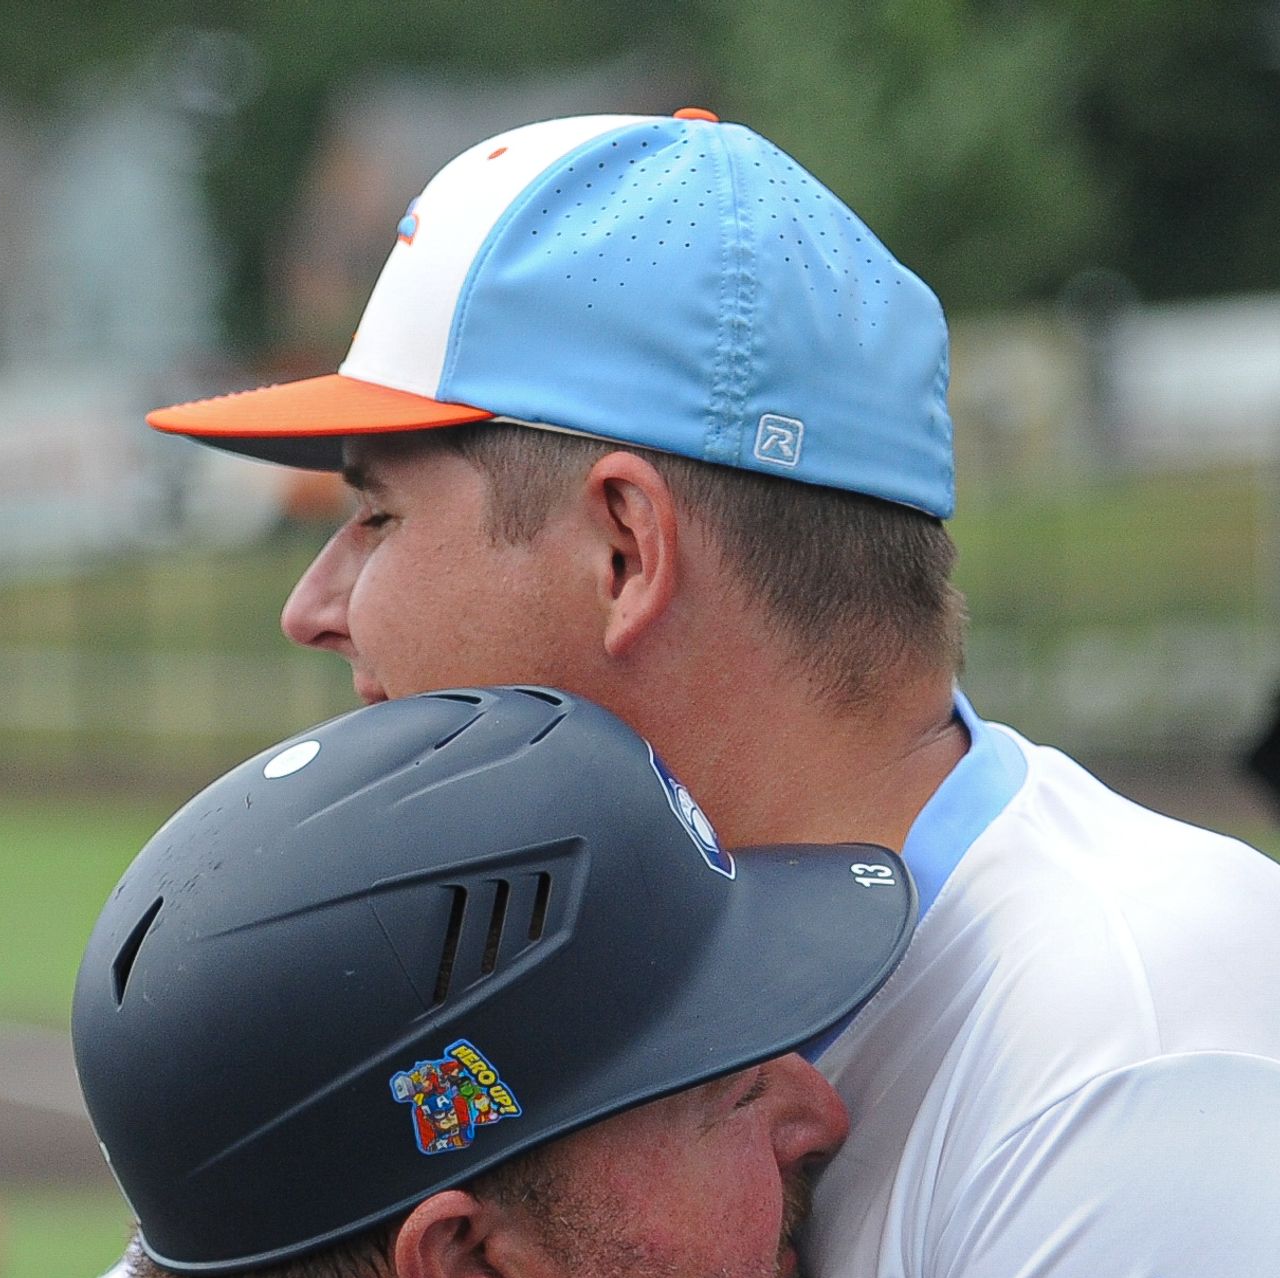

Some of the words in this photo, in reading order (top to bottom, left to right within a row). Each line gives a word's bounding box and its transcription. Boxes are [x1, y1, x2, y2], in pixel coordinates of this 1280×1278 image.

[850, 863, 895, 888] 13
[451, 1045, 496, 1085] HERO
[490, 1086, 518, 1113] UP!
